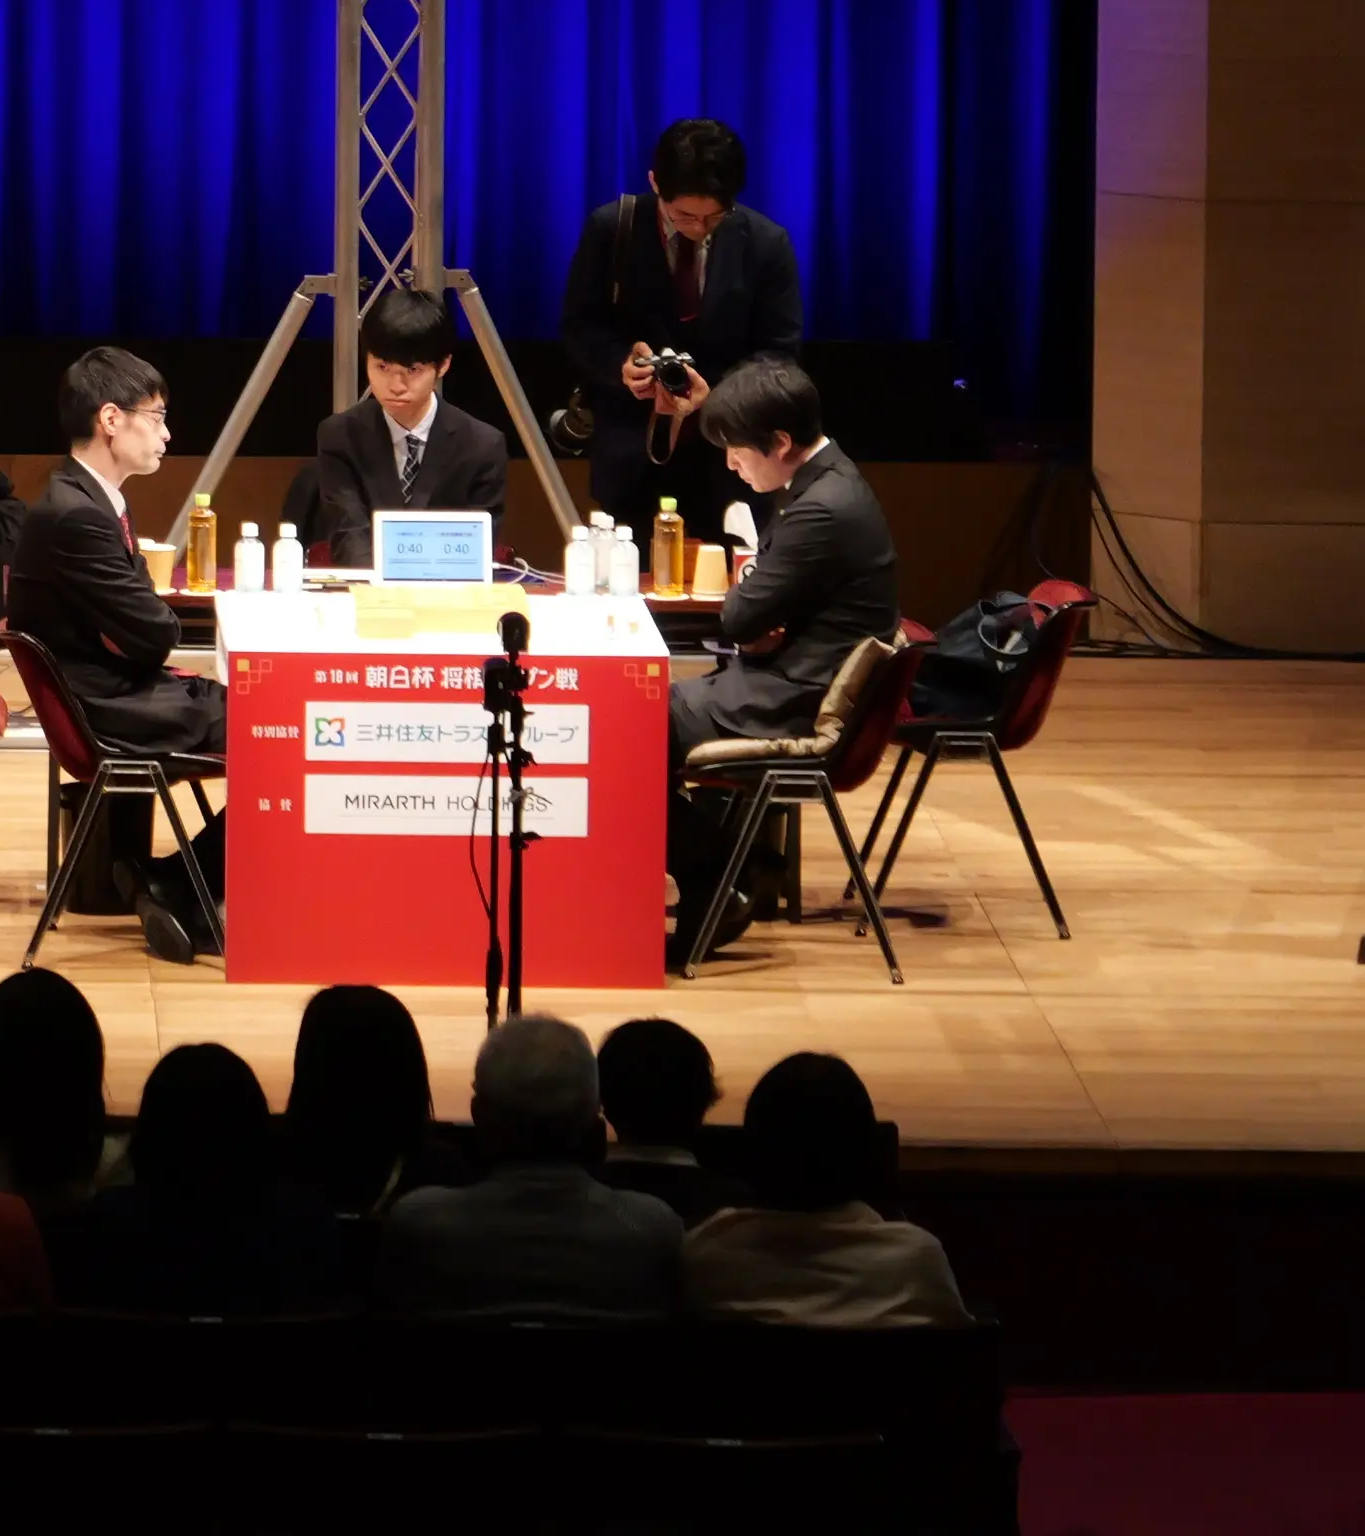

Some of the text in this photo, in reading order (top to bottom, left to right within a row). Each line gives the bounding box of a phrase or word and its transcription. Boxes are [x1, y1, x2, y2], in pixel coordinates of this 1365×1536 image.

[398, 544, 422, 553] 0:40
[444, 544, 469, 554] 0:40
[345, 795, 435, 809] MIRARTH
